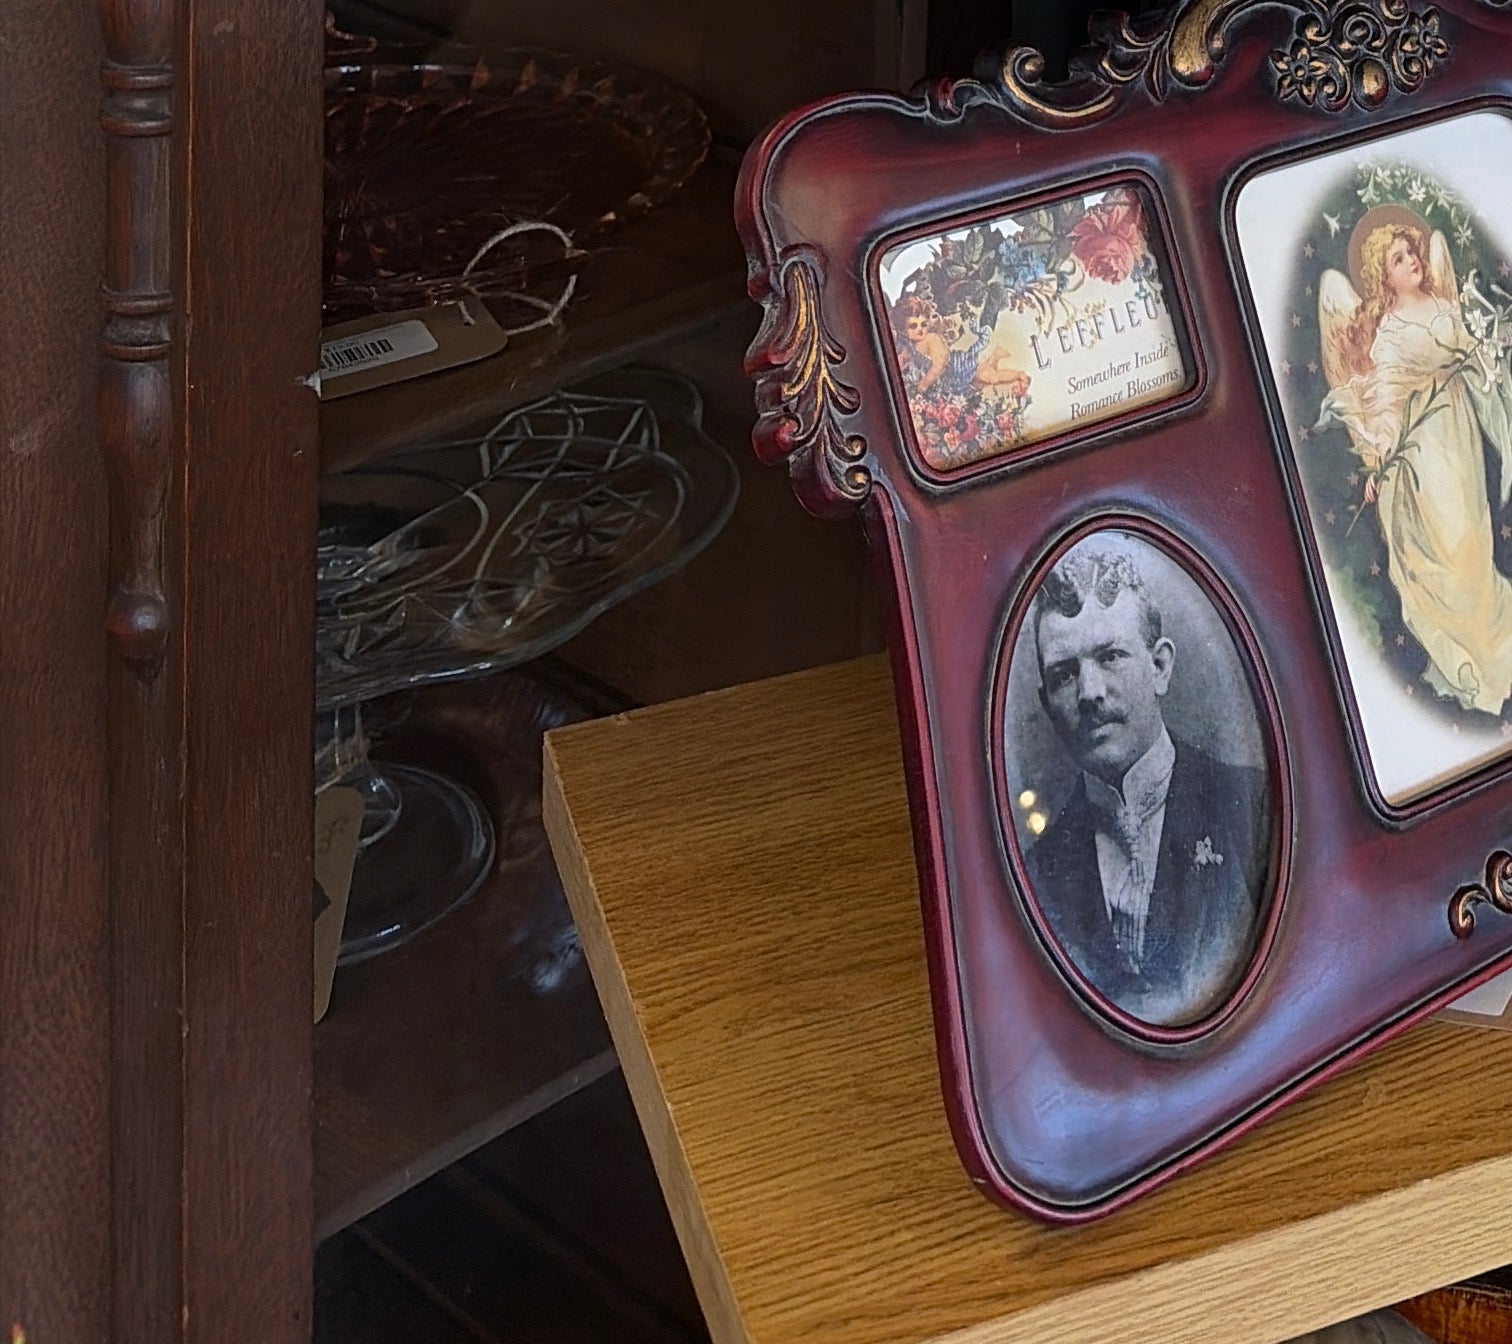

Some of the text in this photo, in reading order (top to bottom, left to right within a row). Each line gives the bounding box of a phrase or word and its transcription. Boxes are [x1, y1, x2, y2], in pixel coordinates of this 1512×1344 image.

[1030, 291, 1170, 370] L'EFFLEU
[1068, 343, 1169, 394] Somewhere Inside
[1071, 368, 1182, 420] Romance Blossoms.
